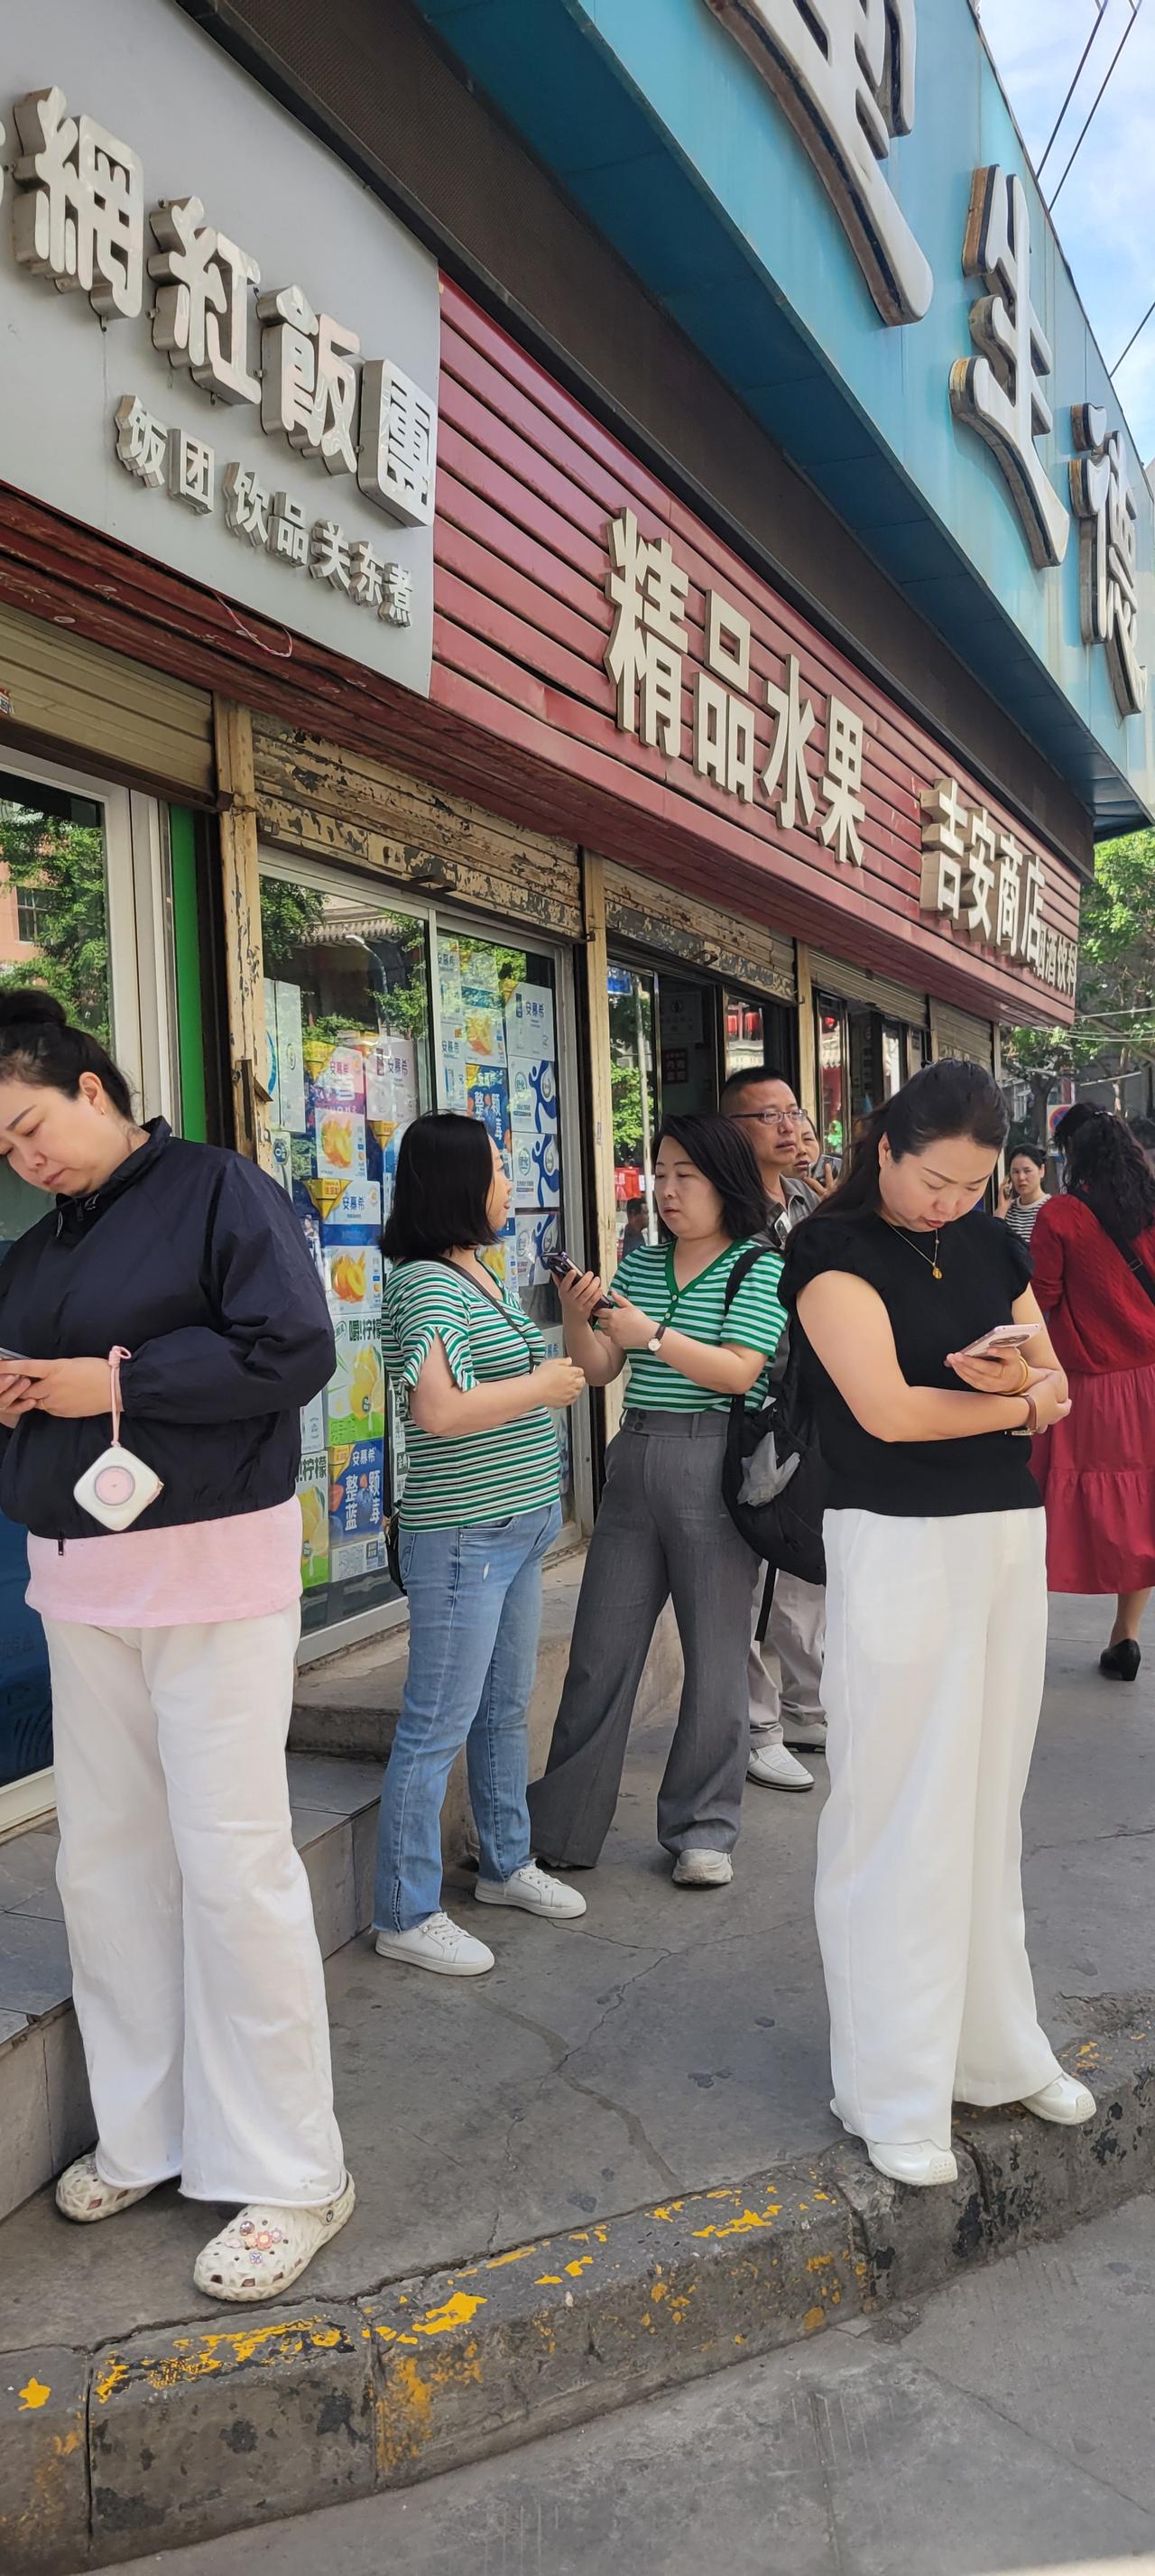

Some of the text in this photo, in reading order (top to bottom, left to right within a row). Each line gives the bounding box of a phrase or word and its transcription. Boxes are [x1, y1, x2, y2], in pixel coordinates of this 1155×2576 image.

[0, 86, 438, 529] 網紅飯團
[605, 507, 864, 866] 精品水果
[920, 778, 1045, 966] 吉安商店
[525, 1001, 544, 1018] 安慕希
[343, 1196, 365, 1210] 安慕希
[352, 1447, 375, 1466] 安慕希
